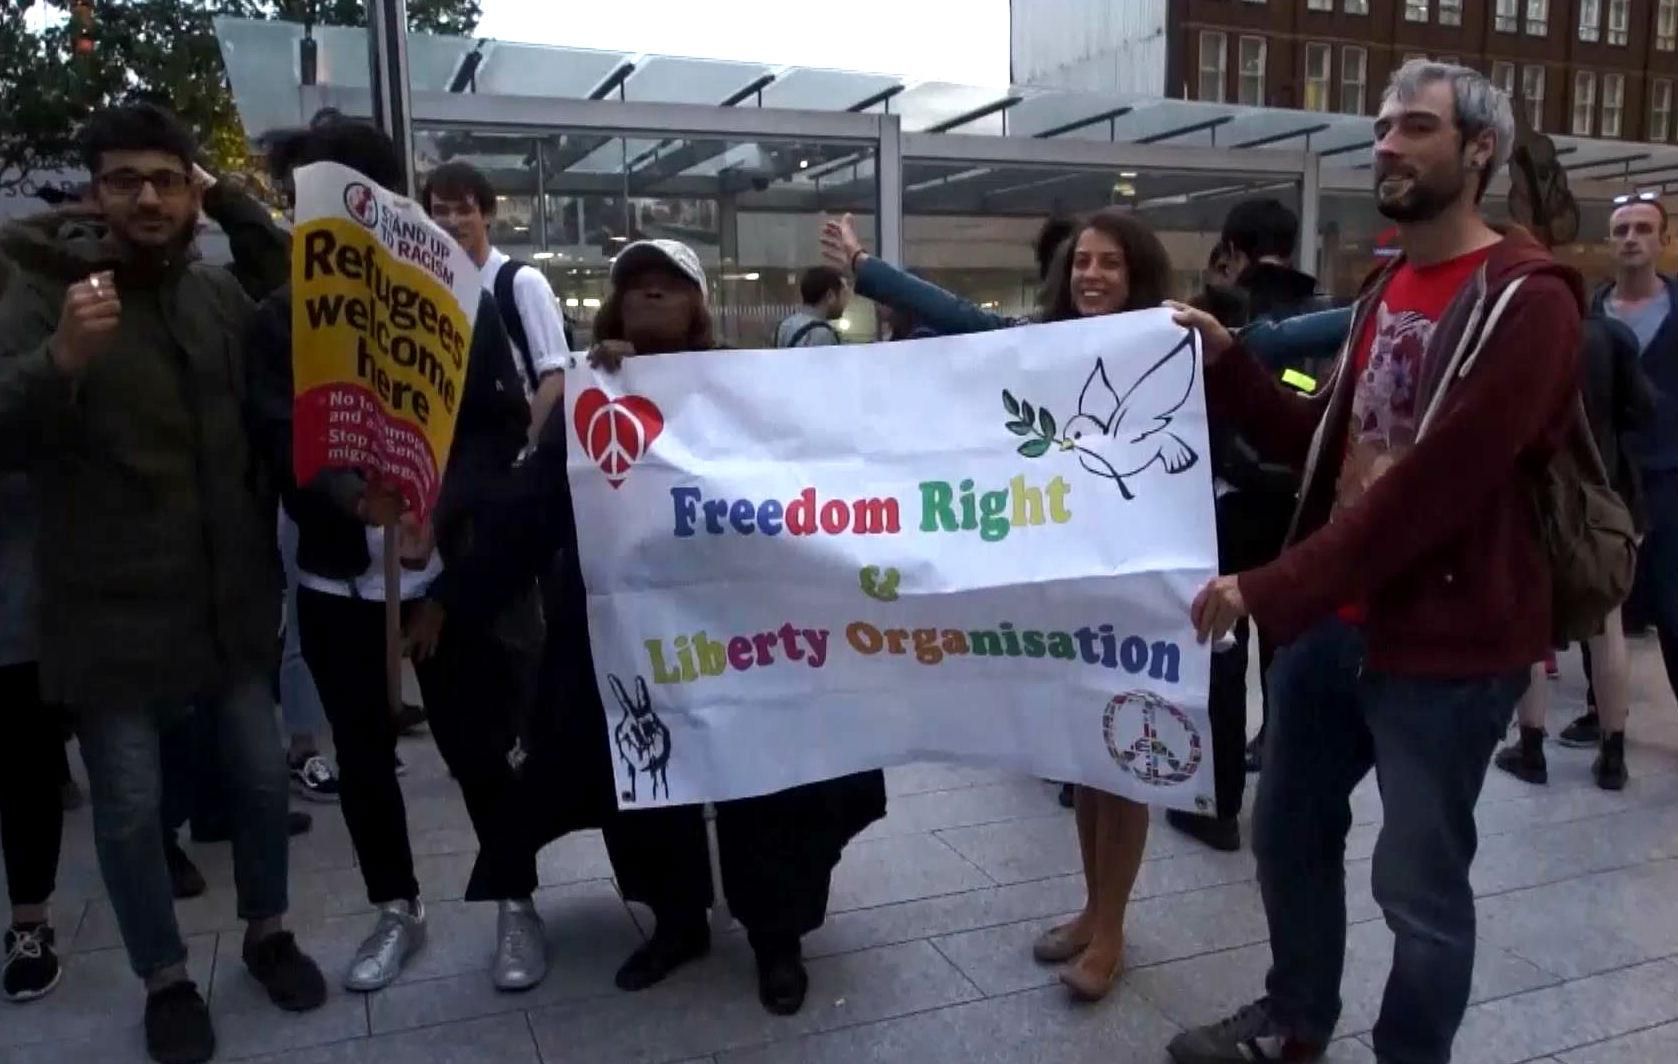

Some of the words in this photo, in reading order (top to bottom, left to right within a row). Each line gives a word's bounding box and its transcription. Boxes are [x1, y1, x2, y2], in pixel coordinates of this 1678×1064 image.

[381, 223, 394, 249] TO
[398, 240, 455, 288] RACISM
[382, 205, 426, 245] STAND
[431, 236, 452, 260] UP
[305, 229, 465, 370] Refugees
[306, 294, 455, 415] welcome
[358, 336, 430, 425] here
[329, 410, 361, 423] and
[330, 391, 354, 406] No
[329, 429, 368, 446] Stop
[670, 486, 900, 537] Freedom
[918, 474, 1072, 541] Right
[859, 564, 900, 600] &
[644, 621, 830, 684] Liberty
[846, 620, 1181, 683] Organisation
